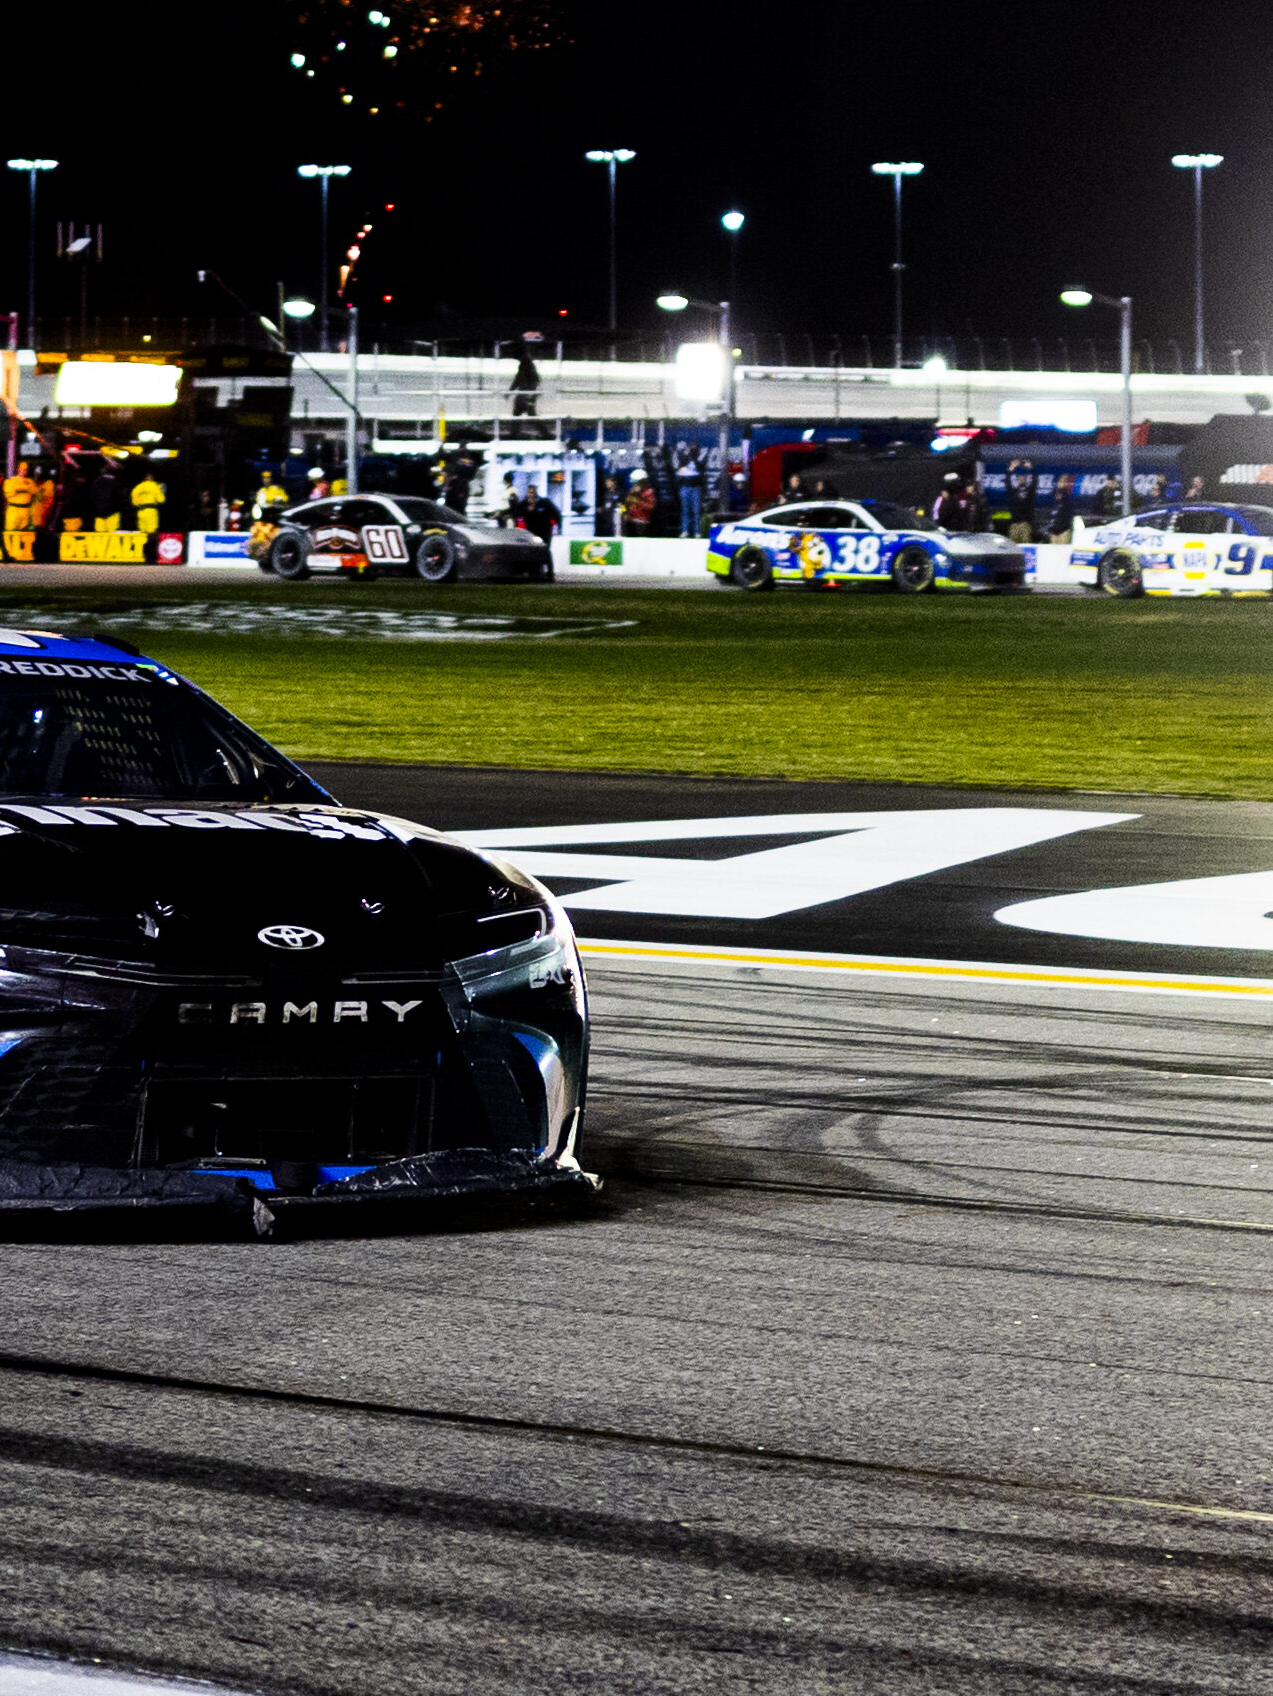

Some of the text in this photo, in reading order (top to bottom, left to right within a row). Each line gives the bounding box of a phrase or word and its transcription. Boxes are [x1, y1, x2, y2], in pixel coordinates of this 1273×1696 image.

[365, 528, 408, 561] 60
[832, 535, 881, 573] 38
[1224, 542, 1257, 576] 9
[178, 1000, 423, 1024] CAMRY
